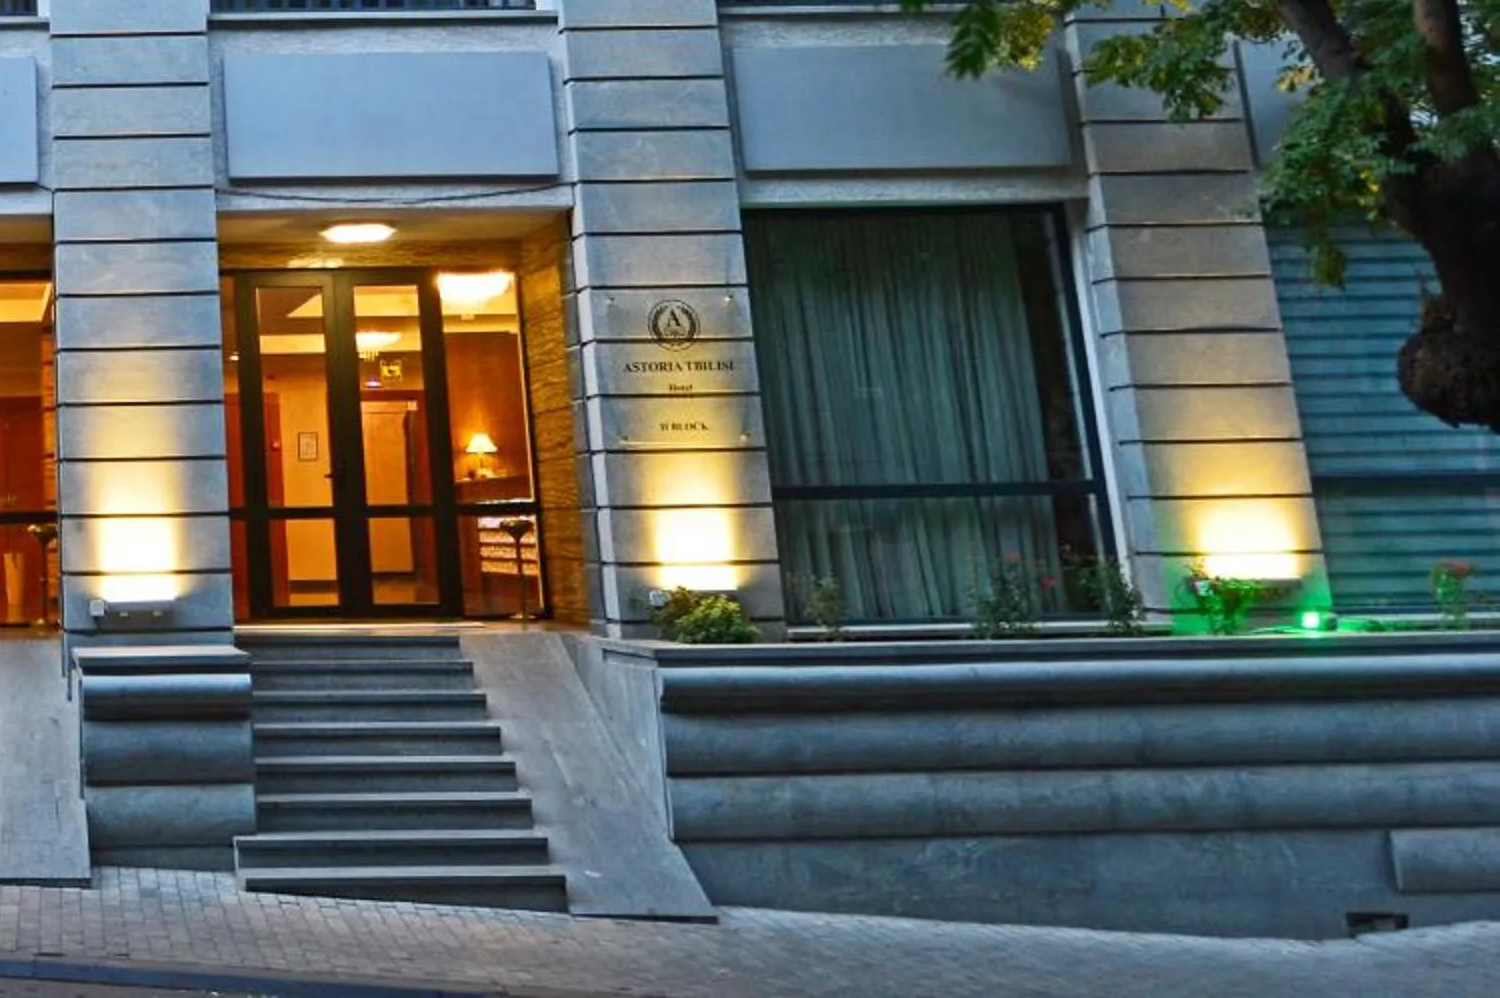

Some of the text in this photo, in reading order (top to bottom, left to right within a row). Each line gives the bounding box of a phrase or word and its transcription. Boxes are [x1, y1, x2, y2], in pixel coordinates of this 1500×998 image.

[623, 360, 735, 374] ASTORIA TBILISI
[669, 383, 693, 392] Hotel
[671, 422, 709, 432] BLOCK
